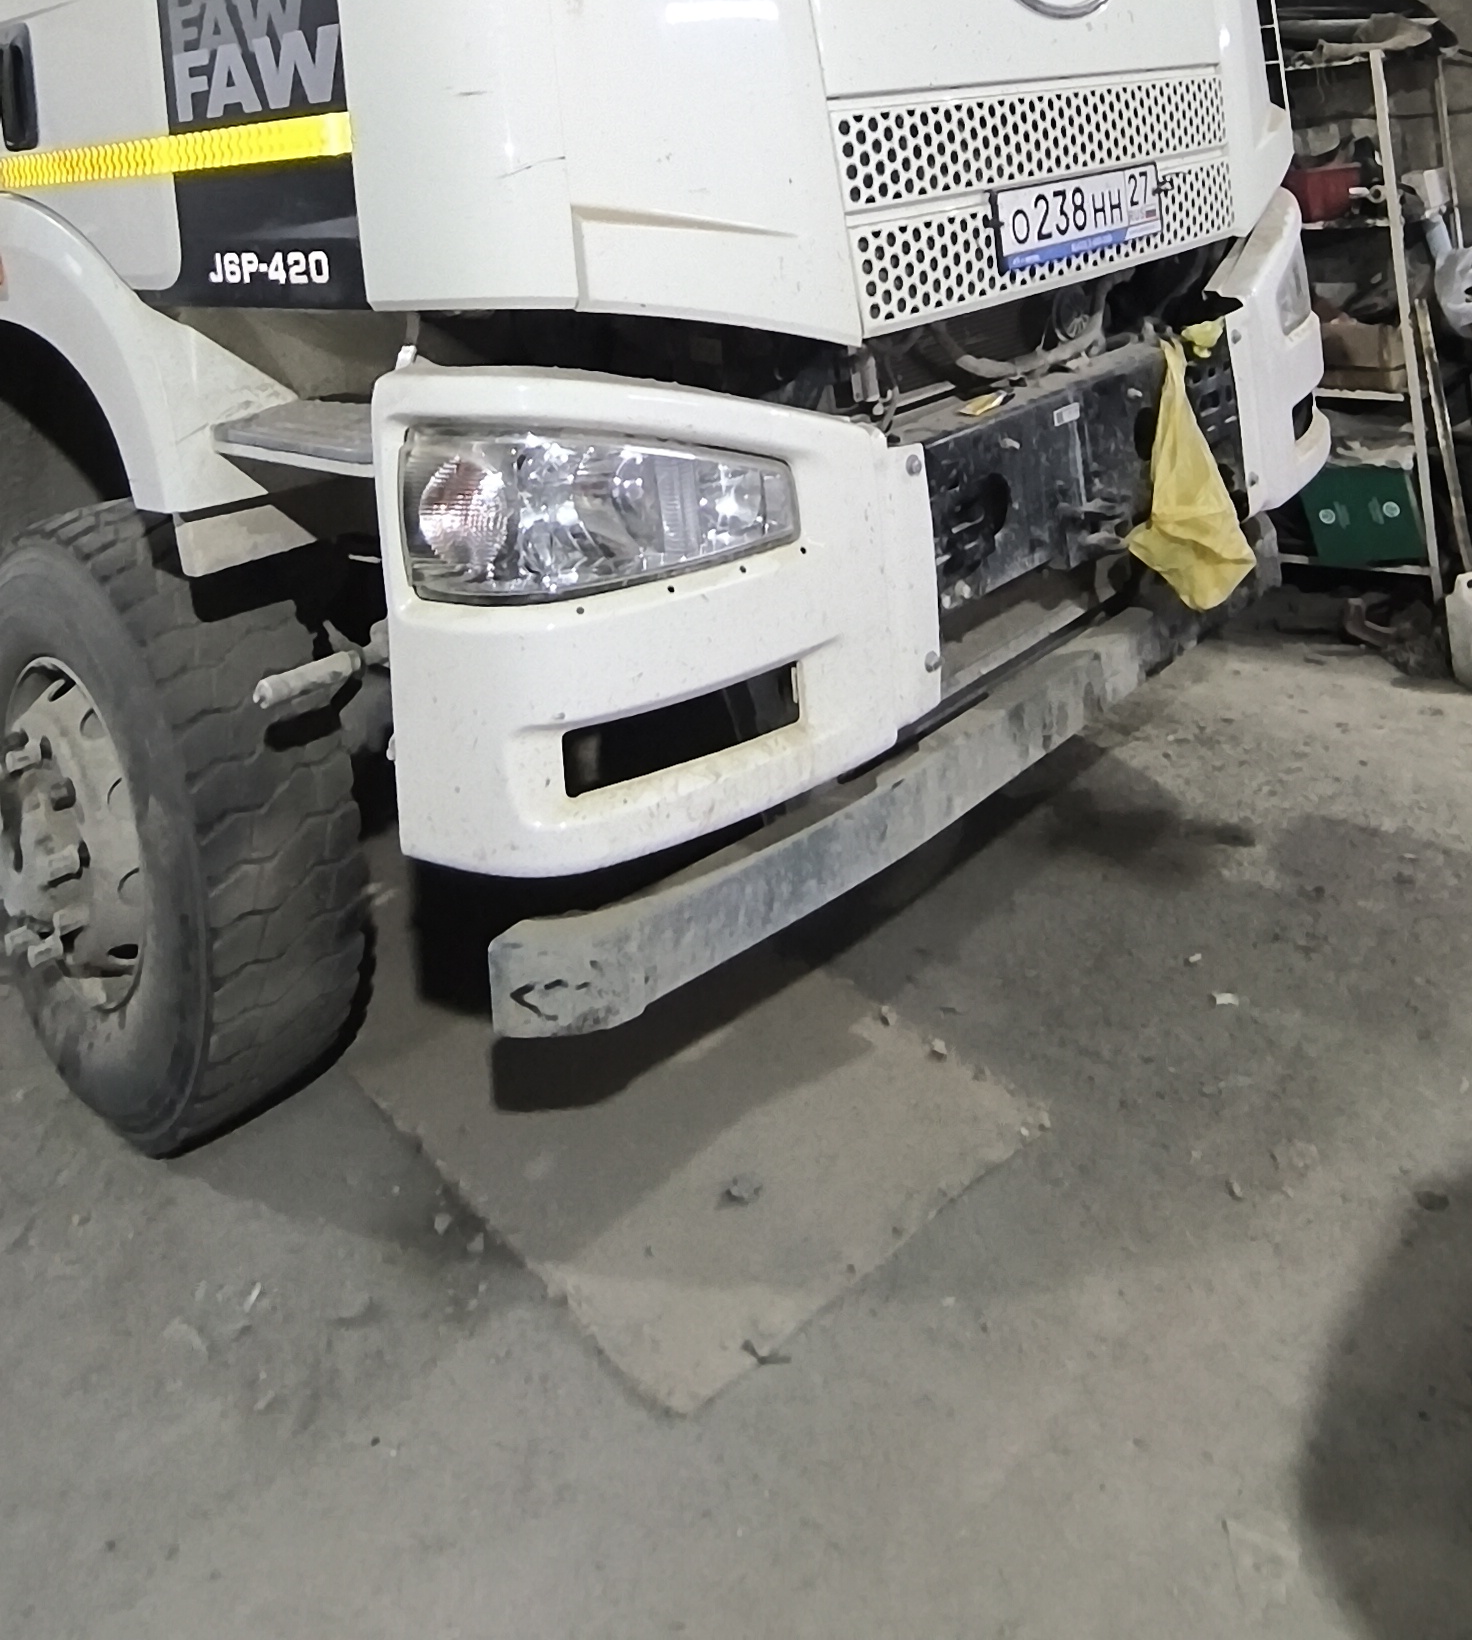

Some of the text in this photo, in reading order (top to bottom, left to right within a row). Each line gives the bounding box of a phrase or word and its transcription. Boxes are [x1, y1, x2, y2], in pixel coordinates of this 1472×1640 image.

[173, 23, 340, 122] FAW
[1127, 171, 1148, 207] 27
[208, 250, 330, 284] J6P-420
